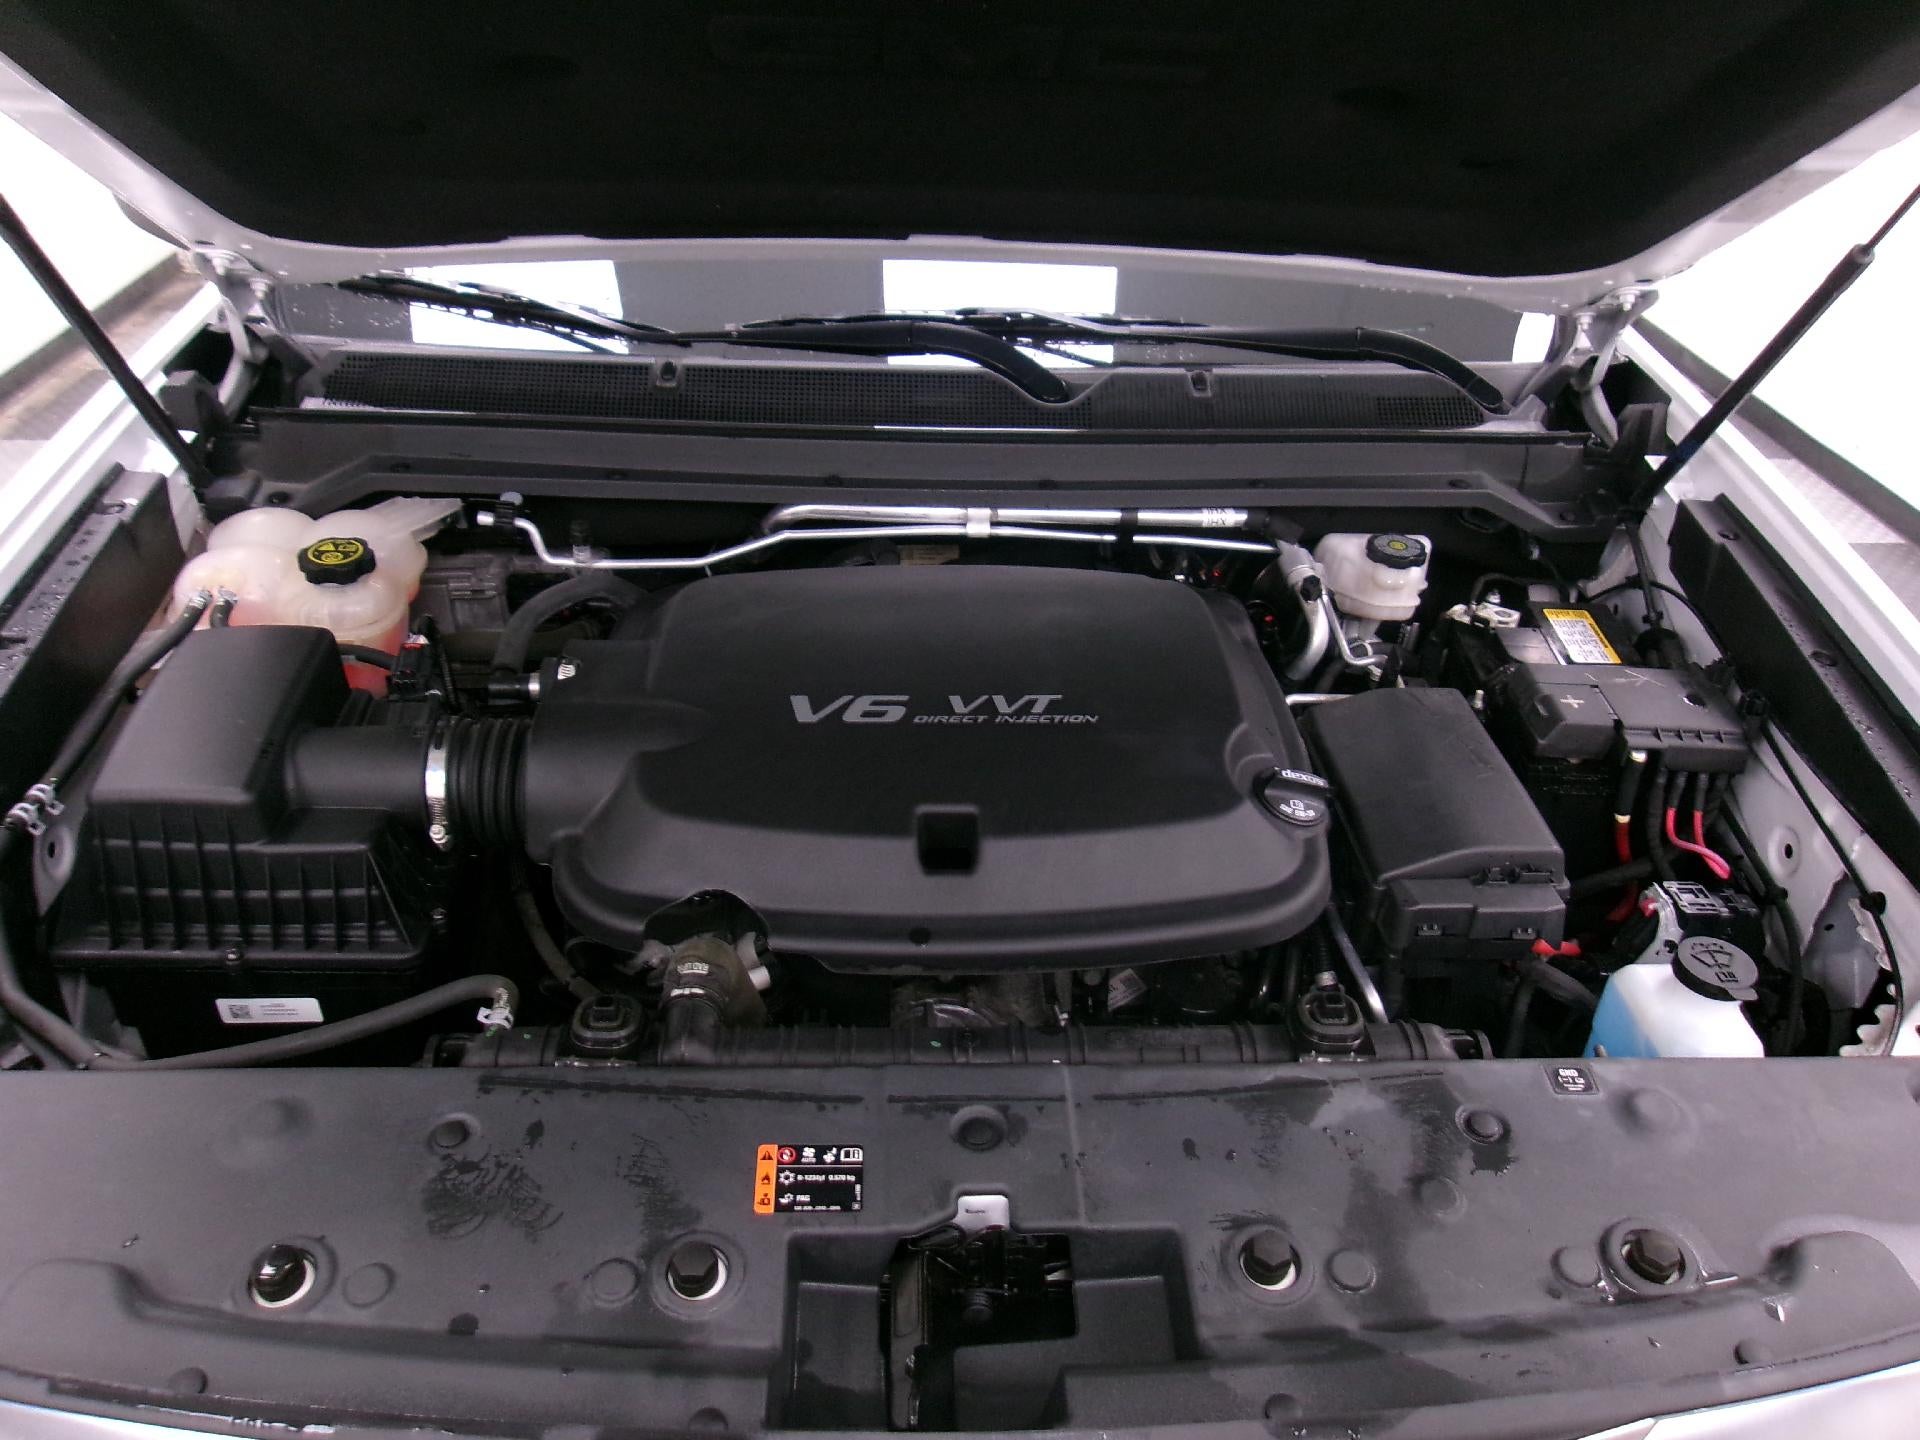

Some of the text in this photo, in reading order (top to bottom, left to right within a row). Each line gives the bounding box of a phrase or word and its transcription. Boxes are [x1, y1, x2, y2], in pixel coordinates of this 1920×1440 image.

[789, 694, 1063, 724] V6 VVT
[913, 714, 1099, 725] DIRECT INJECTION
[1281, 769, 1324, 786] dexos
